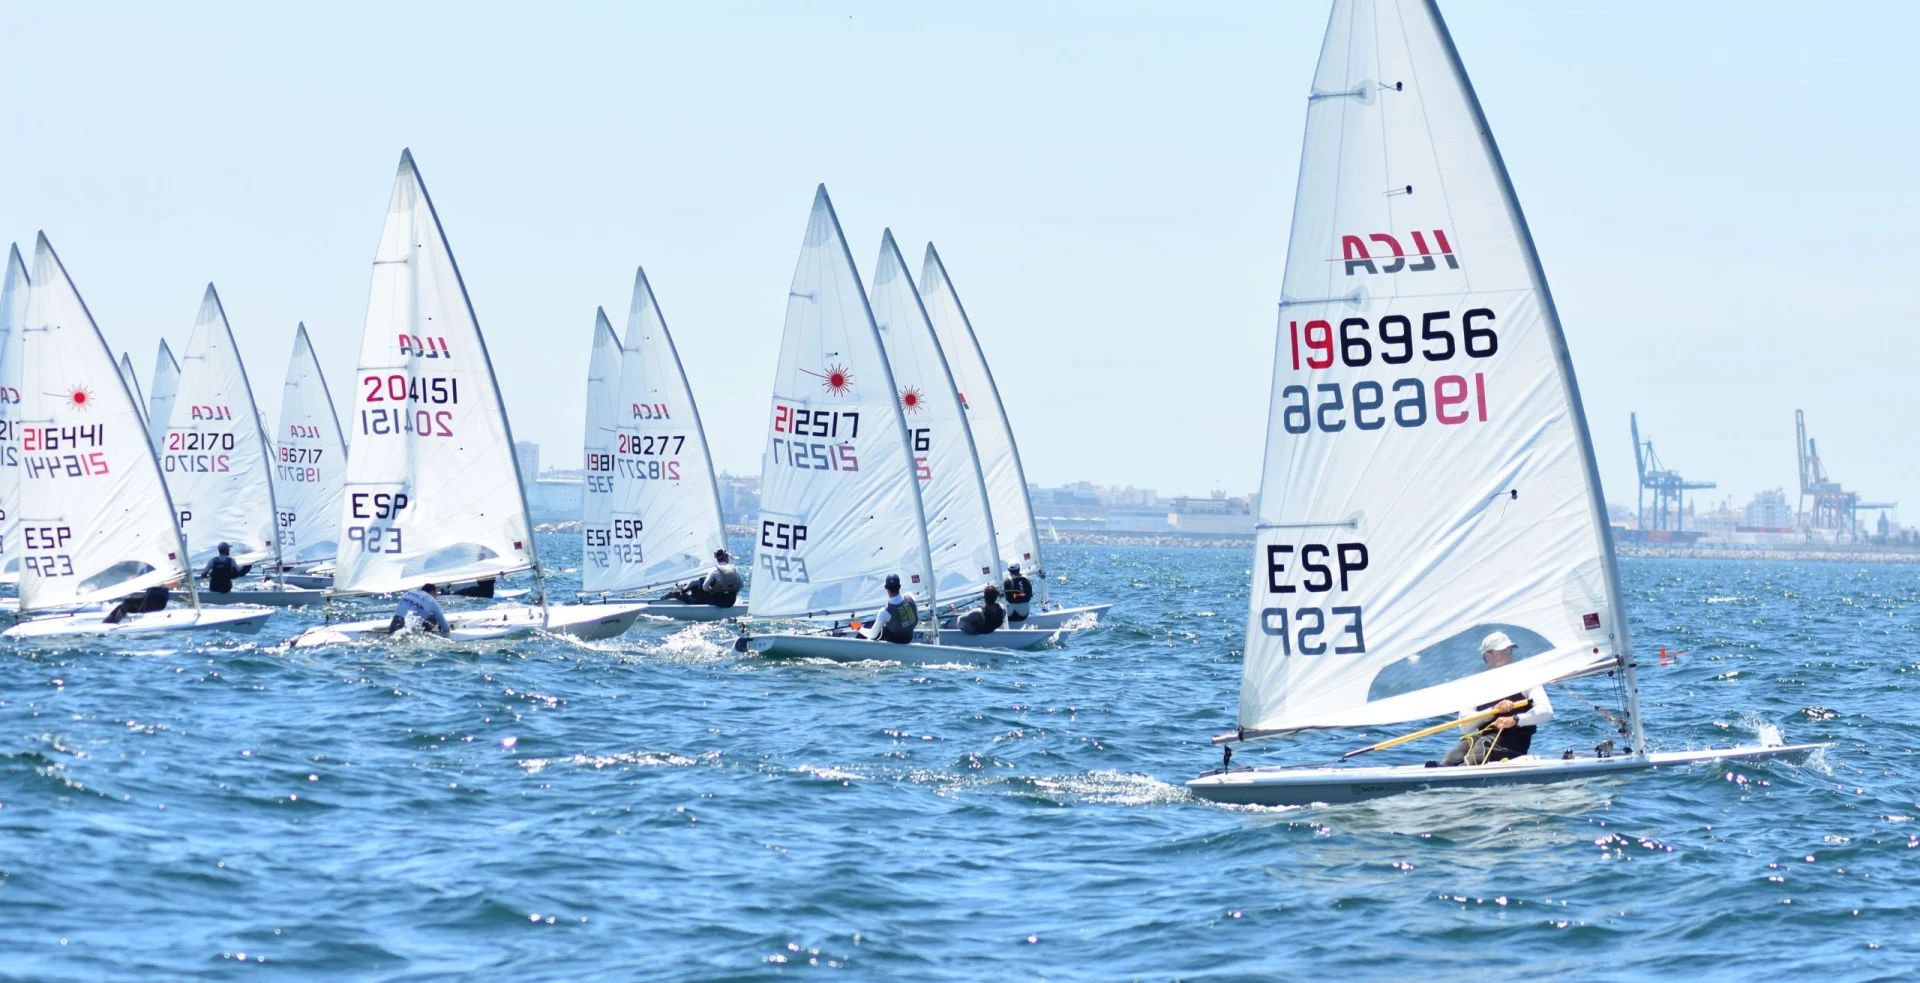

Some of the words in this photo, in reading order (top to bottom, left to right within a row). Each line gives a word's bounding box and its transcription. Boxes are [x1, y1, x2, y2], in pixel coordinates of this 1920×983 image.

[1290, 307, 1498, 370] 196956
[363, 374, 458, 404] 204151
[774, 405, 859, 438] 212517
[24, 423, 103, 450] 216441
[169, 432, 234, 451] 212170
[618, 433, 686, 456] 218277
[278, 446, 323, 464] 196717
[276, 511, 296, 527] SP
[352, 493, 408, 520] ESP
[24, 527, 71, 550] ESP
[614, 519, 643, 539] ESP
[761, 520, 808, 551] ESP
[1267, 542, 1369, 593] ESP
